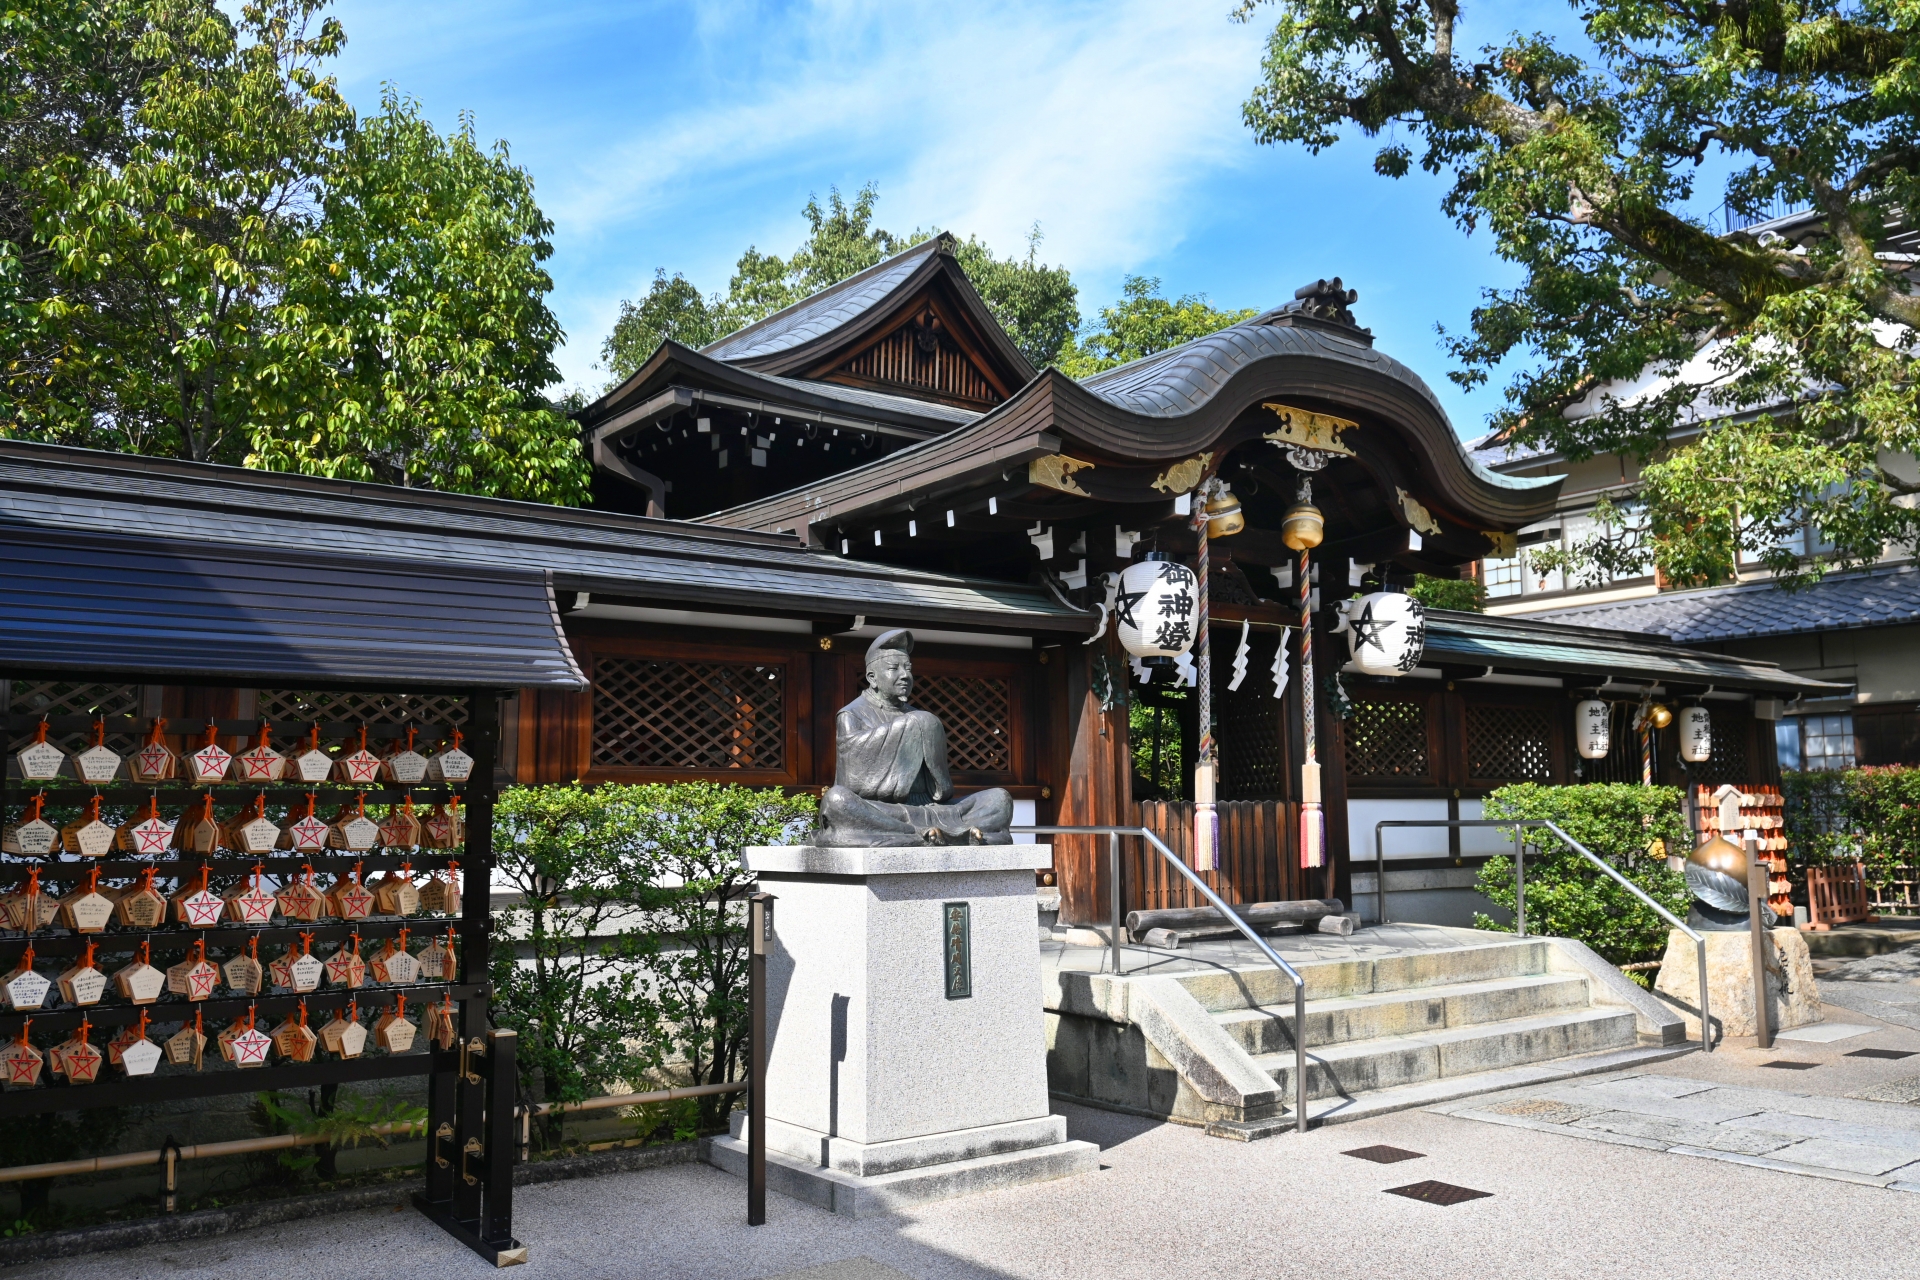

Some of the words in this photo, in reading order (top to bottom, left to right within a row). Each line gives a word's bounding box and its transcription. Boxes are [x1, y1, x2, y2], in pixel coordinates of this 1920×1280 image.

[1151, 562, 1194, 651] 御神燈
[1588, 706, 1601, 751] 地主社
[1691, 712, 1703, 755] 地主社
